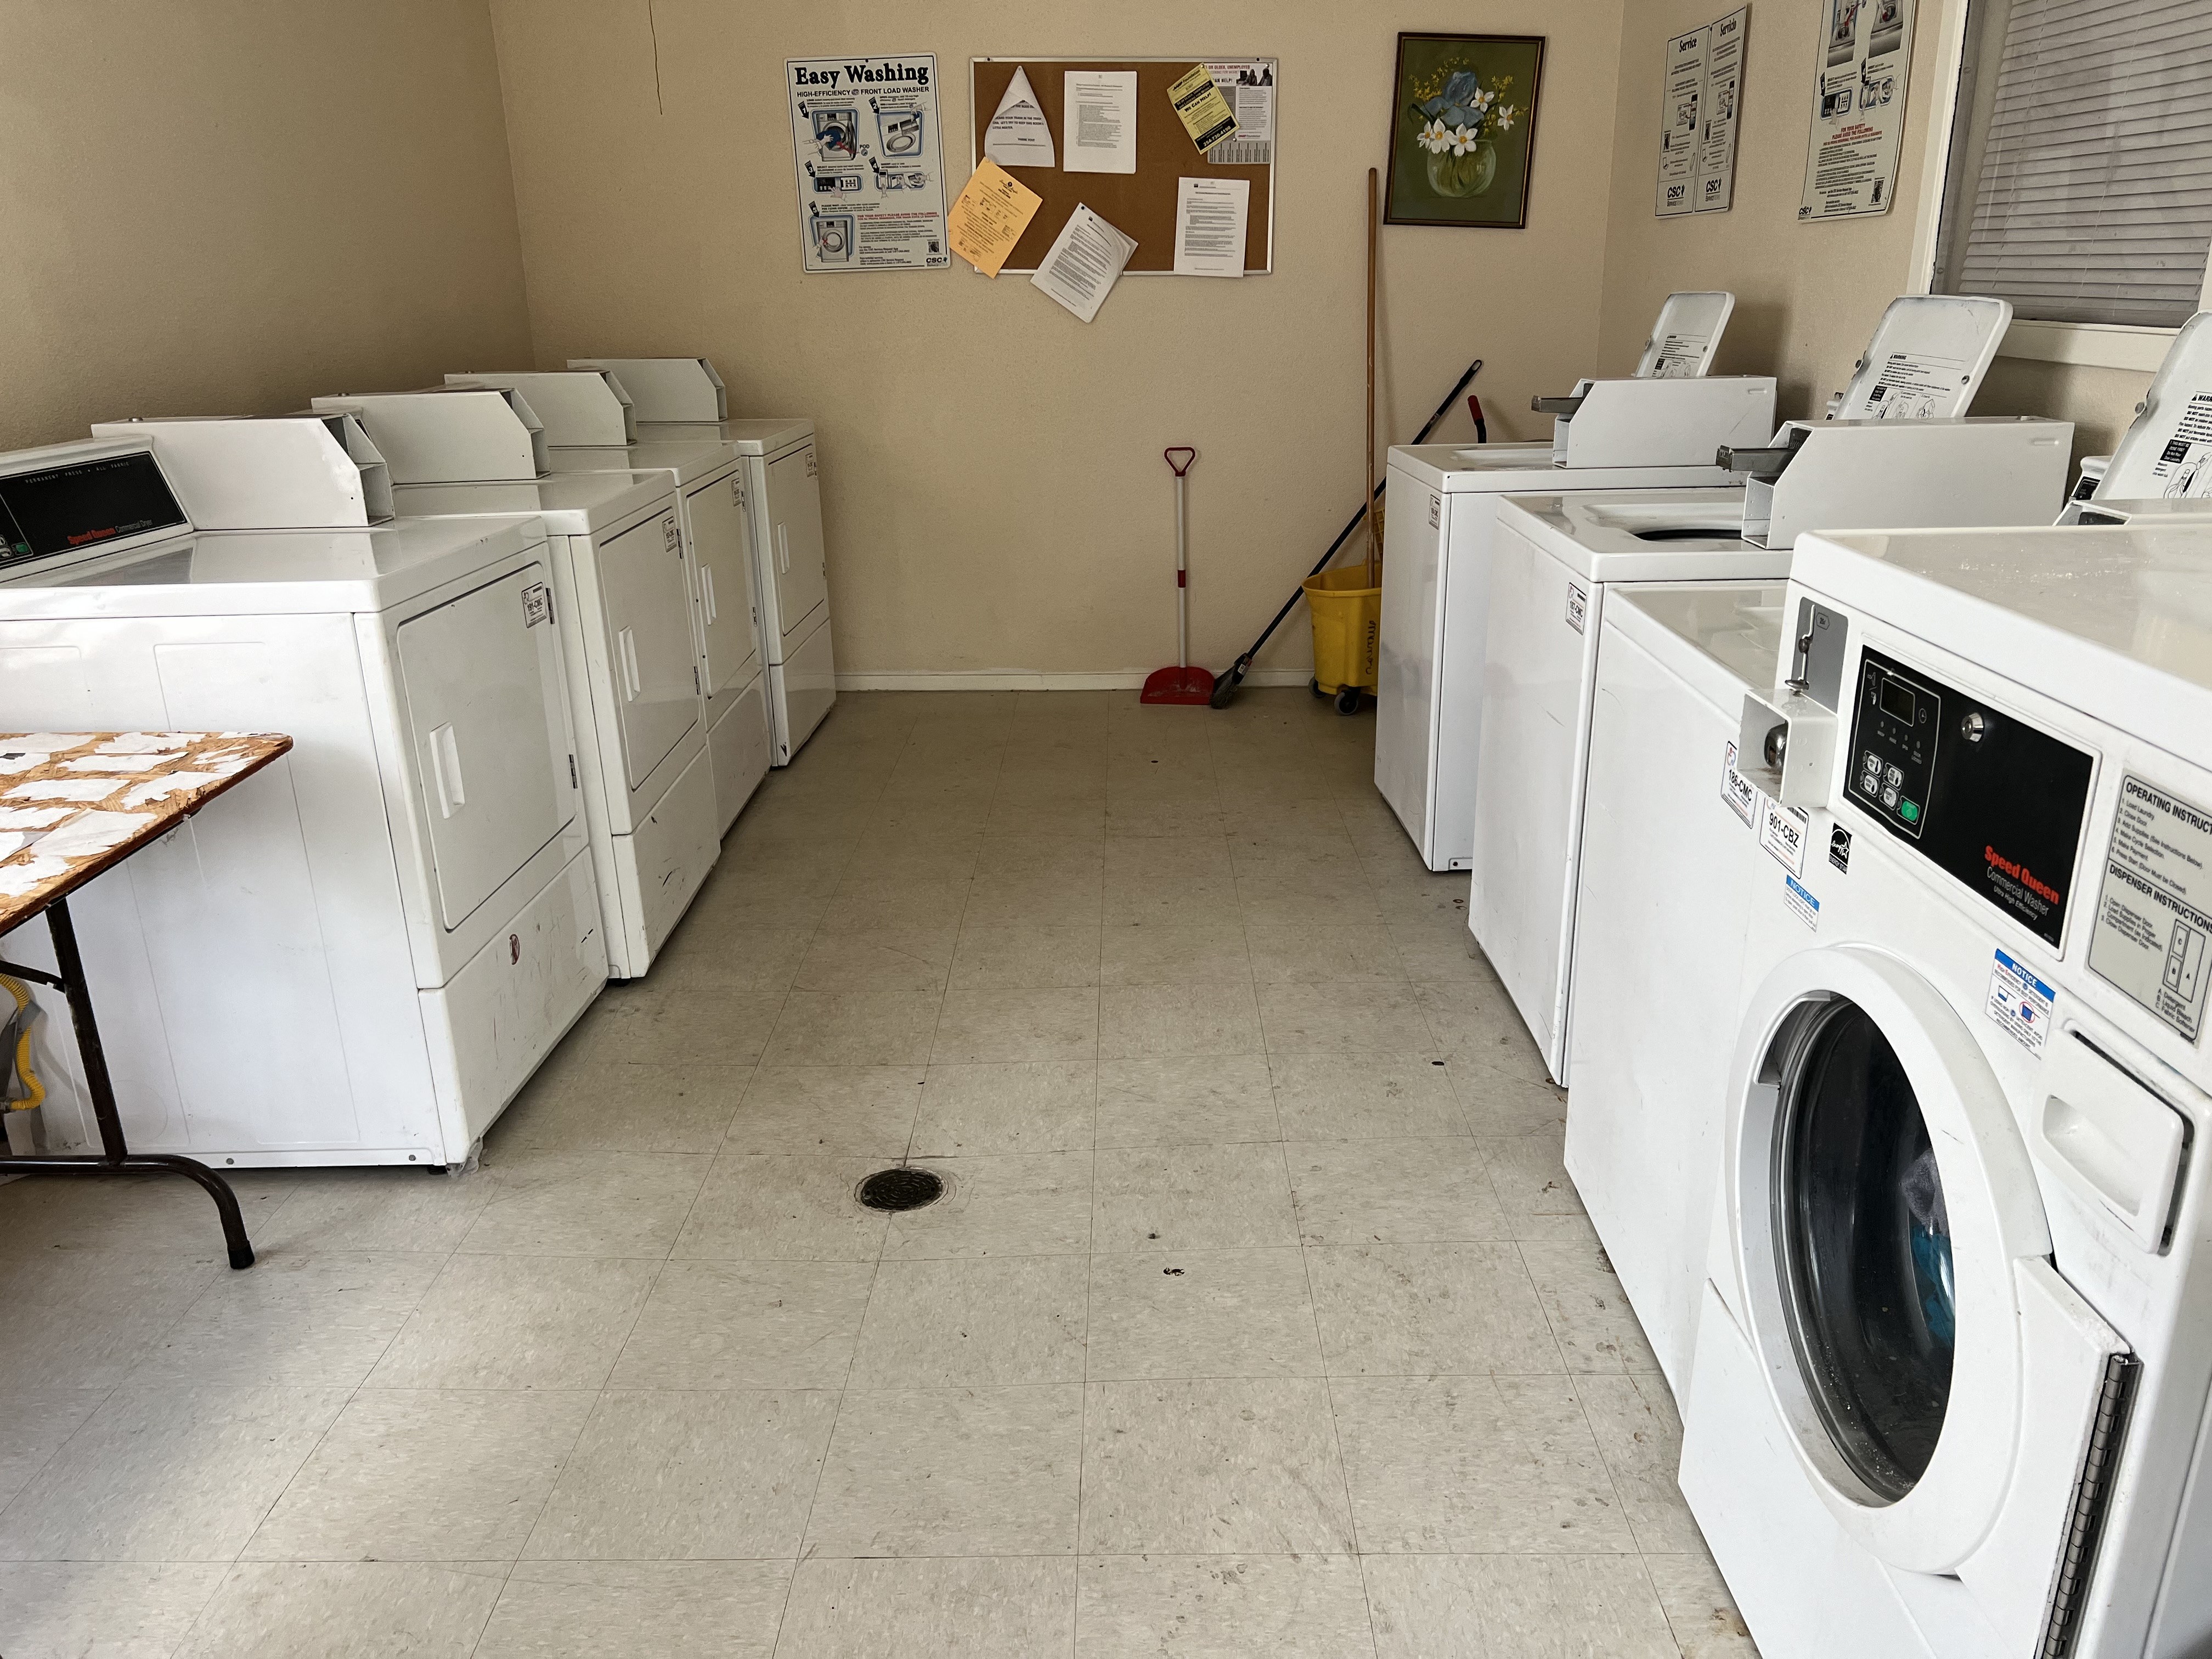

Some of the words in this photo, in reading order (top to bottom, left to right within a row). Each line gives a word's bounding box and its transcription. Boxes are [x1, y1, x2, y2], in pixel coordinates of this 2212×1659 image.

[1720, 18, 1736, 37] Servicio
[1679, 37, 1697, 53] Service
[794, 67, 840, 89] Easy
[843, 63, 929, 85] Washing
[1668, 186, 1680, 198] CSC
[1706, 179, 1718, 193] CSC
[25, 474, 58, 483] PERMANENT
[67, 531, 93, 545] Speed
[91, 528, 116, 539] Queen
[115, 522, 140, 533] Commercial
[140, 519, 153, 528] Dryer
[1729, 769, 1752, 802] 186-CMC
[2125, 781, 2171, 814] OPERATING
[2124, 810, 2136, 821] Close
[2126, 800, 2138, 811] Load
[1769, 812, 1799, 848] 901-CBZ
[2122, 820, 2131, 830] Add
[2131, 825, 2149, 840] Supplies
[2160, 841, 2186, 859] Instructions
[2131, 836, 2145, 849] Cycle
[2118, 839, 2130, 850] Make
[1829, 855, 1839, 868] ENERGY
[2115, 849, 2128, 861] Press
[2162, 876, 2169, 885] be
[1984, 845, 2021, 879] Speed
[2021, 868, 2059, 905] Queen
[2109, 864, 2153, 898] DISPENSER
[1790, 879, 1815, 907] NOTICE
[1987, 866, 2023, 899] Commercial
[2024, 889, 2049, 916] Washer
[1994, 885, 2005, 899] Ultra
[2004, 891, 2015, 905] High
[2015, 897, 2038, 921] Efficiency
[2106, 911, 2134, 933] Compartment
[2108, 905, 2119, 916] Load
[2119, 911, 2136, 927] Supplies
[2109, 897, 2120, 910] Open
[2120, 904, 2142, 922] Dispenser
[2104, 918, 2117, 930] Close
[2117, 926, 2138, 943] Dispenser
[2177, 937, 2182, 946] C
[2011, 962, 2037, 988] NOTICE
[2162, 998, 2176, 1013] Liquid
[2176, 1008, 2192, 1023] Bleach
[2163, 992, 2186, 1011] Detergent
[2161, 1006, 2176, 1020] Fabric
[2175, 1015, 2195, 1033] Softener
